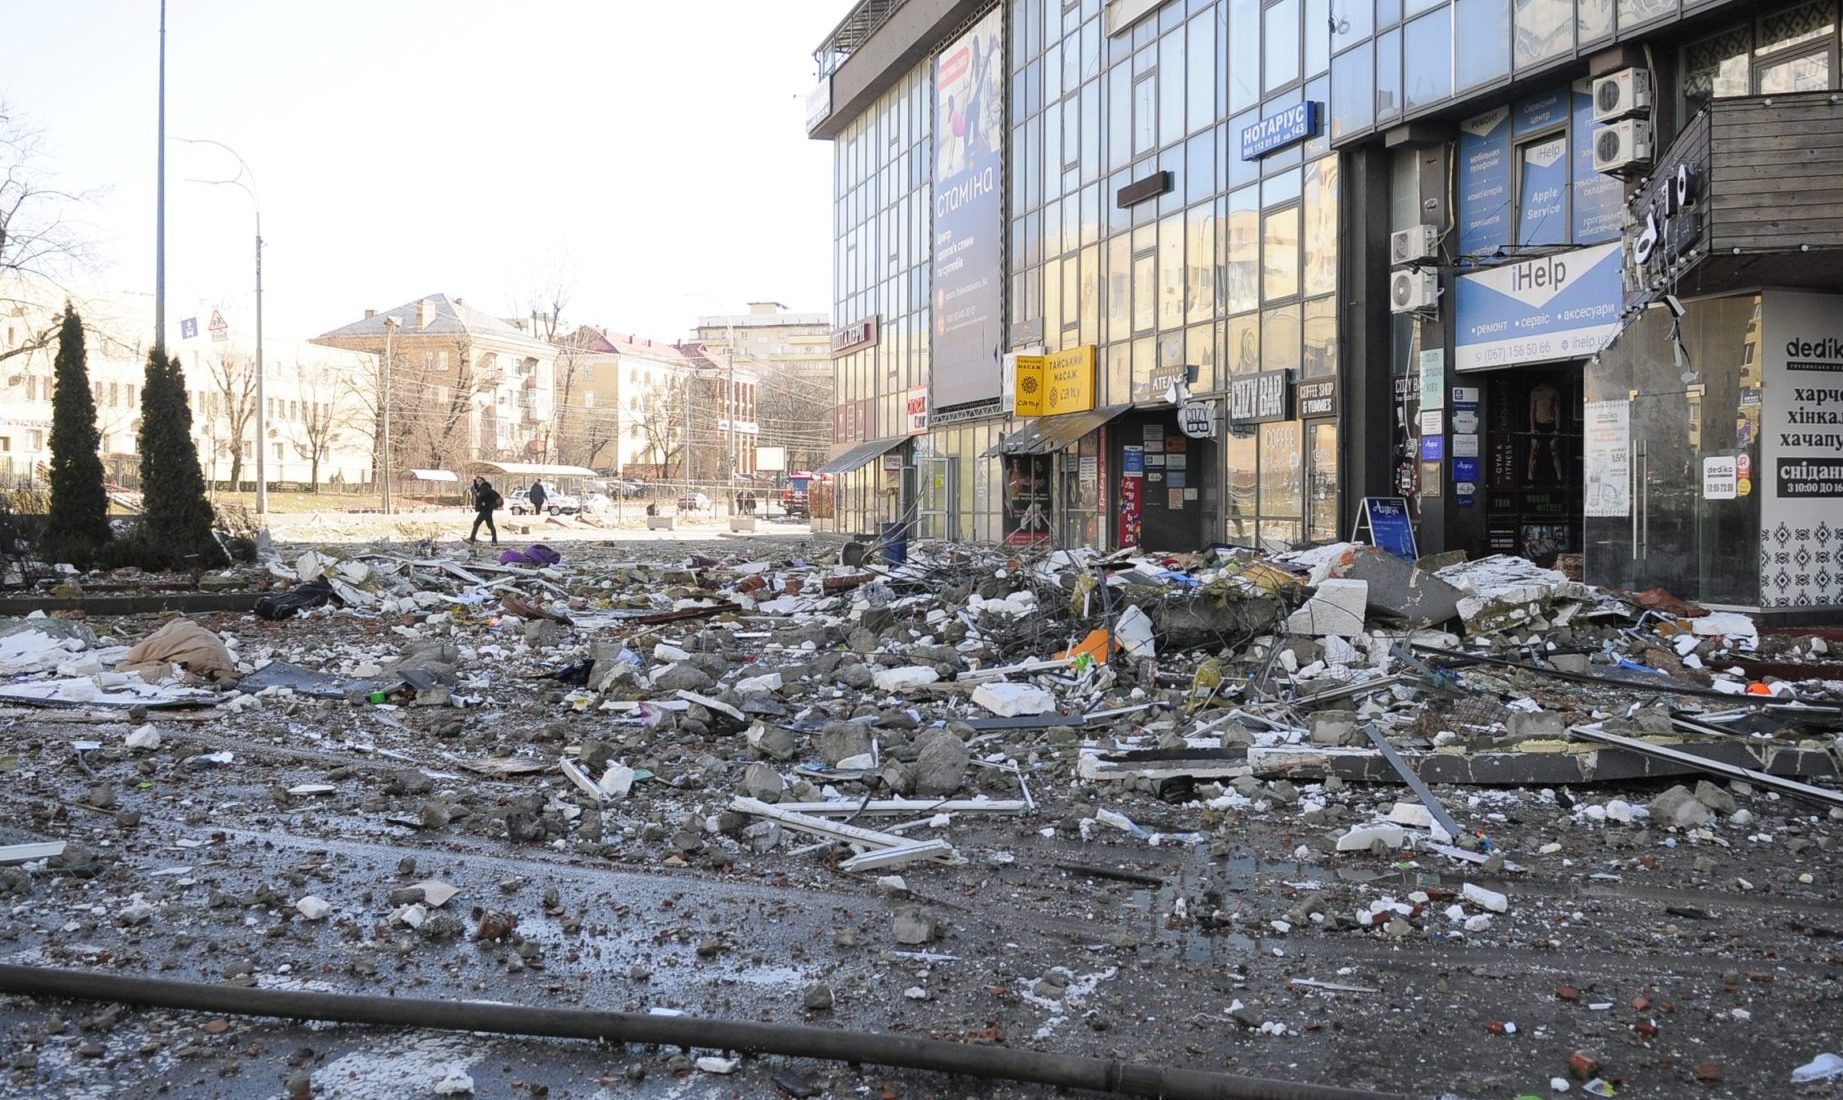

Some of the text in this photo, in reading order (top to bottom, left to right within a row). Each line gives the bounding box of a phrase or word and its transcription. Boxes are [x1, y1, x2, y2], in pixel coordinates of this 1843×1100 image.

[1243, 105, 1304, 146] НОТАРІУС
[1536, 143, 1560, 160] iHelp
[936, 166, 994, 218] стаміна
[1532, 186, 1558, 204] Apple
[1527, 203, 1561, 220] Service
[1512, 256, 1566, 292] iHelp
[1476, 302, 1615, 336] ремонт сервіс аксесуари
[1484, 345, 1506, 362] (067)
[1508, 343, 1524, 358] 156
[1526, 342, 1537, 356] 50
[1539, 341, 1551, 355] 66
[1049, 353, 1083, 370] ТАЙСЬКИЙ
[1054, 368, 1078, 382] МАСАЖ
[1300, 382, 1334, 398] COFFEE SHOP
[1395, 379, 1413, 394] COZY
[1231, 374, 1282, 419] COZY BAR
[1265, 428, 1295, 449] COFFEE
[1504, 444, 1513, 481] FITNESS
[1795, 483, 1818, 493] 10:00
[1819, 483, 1833, 494] ДО
